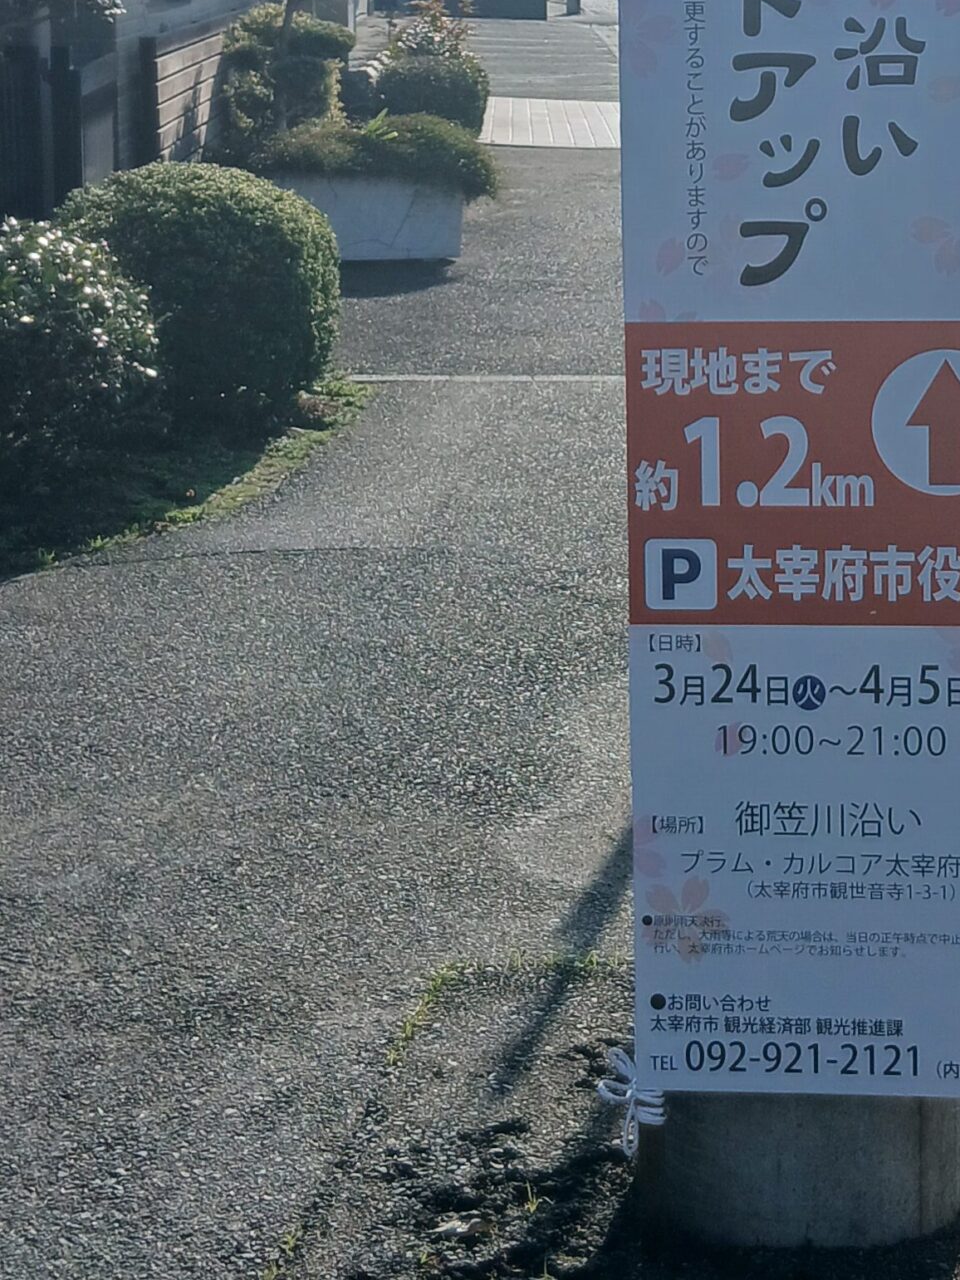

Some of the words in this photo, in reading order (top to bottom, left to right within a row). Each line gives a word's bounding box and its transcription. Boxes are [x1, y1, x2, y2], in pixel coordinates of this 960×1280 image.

[639, 346, 838, 396] 現地まで
[735, 800, 922, 838] 御笠川沿い
[650, 1015, 719, 1034] 太宰府市
[724, 1017, 812, 1035] 観光経済部
[816, 1019, 904, 1038] 観光推進課
[650, 1055, 678, 1072] TEL
[684, 1039, 919, 1077] 092-921-2121
